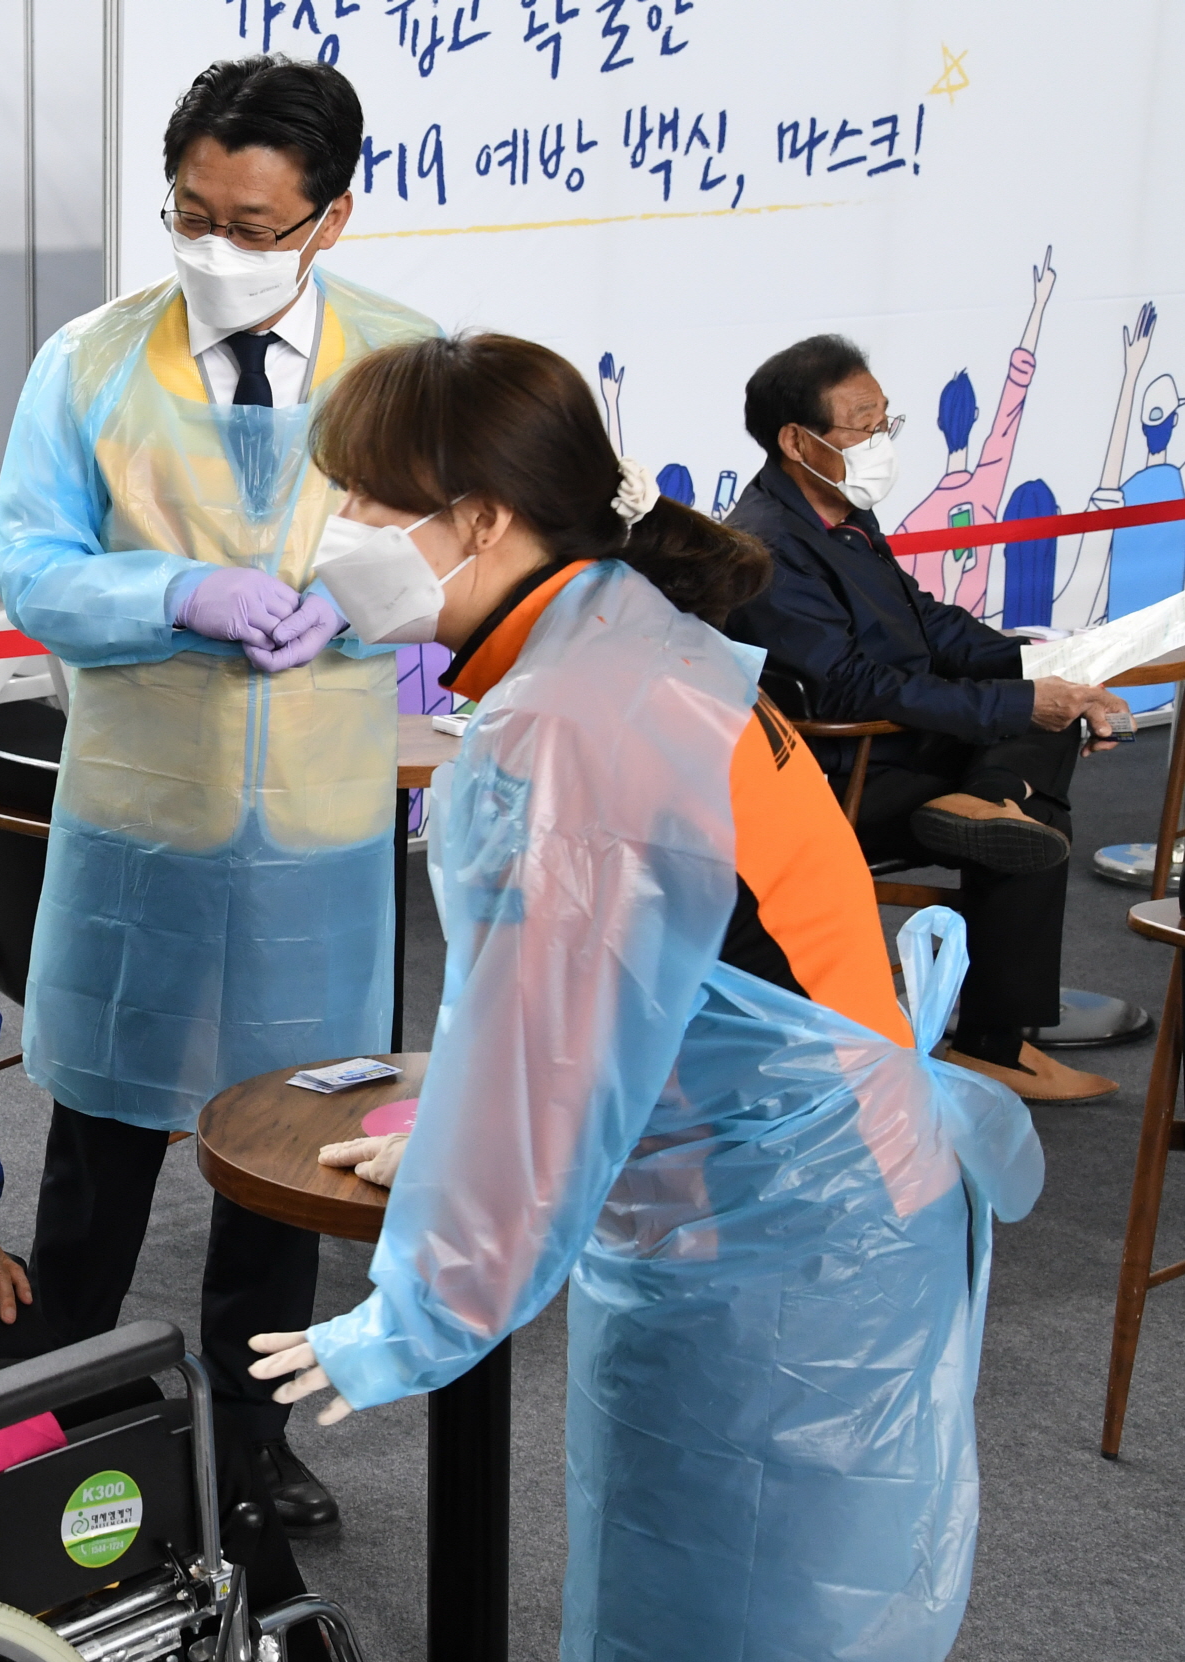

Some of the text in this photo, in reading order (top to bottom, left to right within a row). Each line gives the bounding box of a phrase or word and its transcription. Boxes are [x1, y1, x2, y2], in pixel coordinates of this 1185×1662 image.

[476, 118, 598, 192] 예방
[623, 104, 744, 209] 백신,
[777, 102, 925, 177] 마스크!
[82, 1481, 125, 1503] K300
